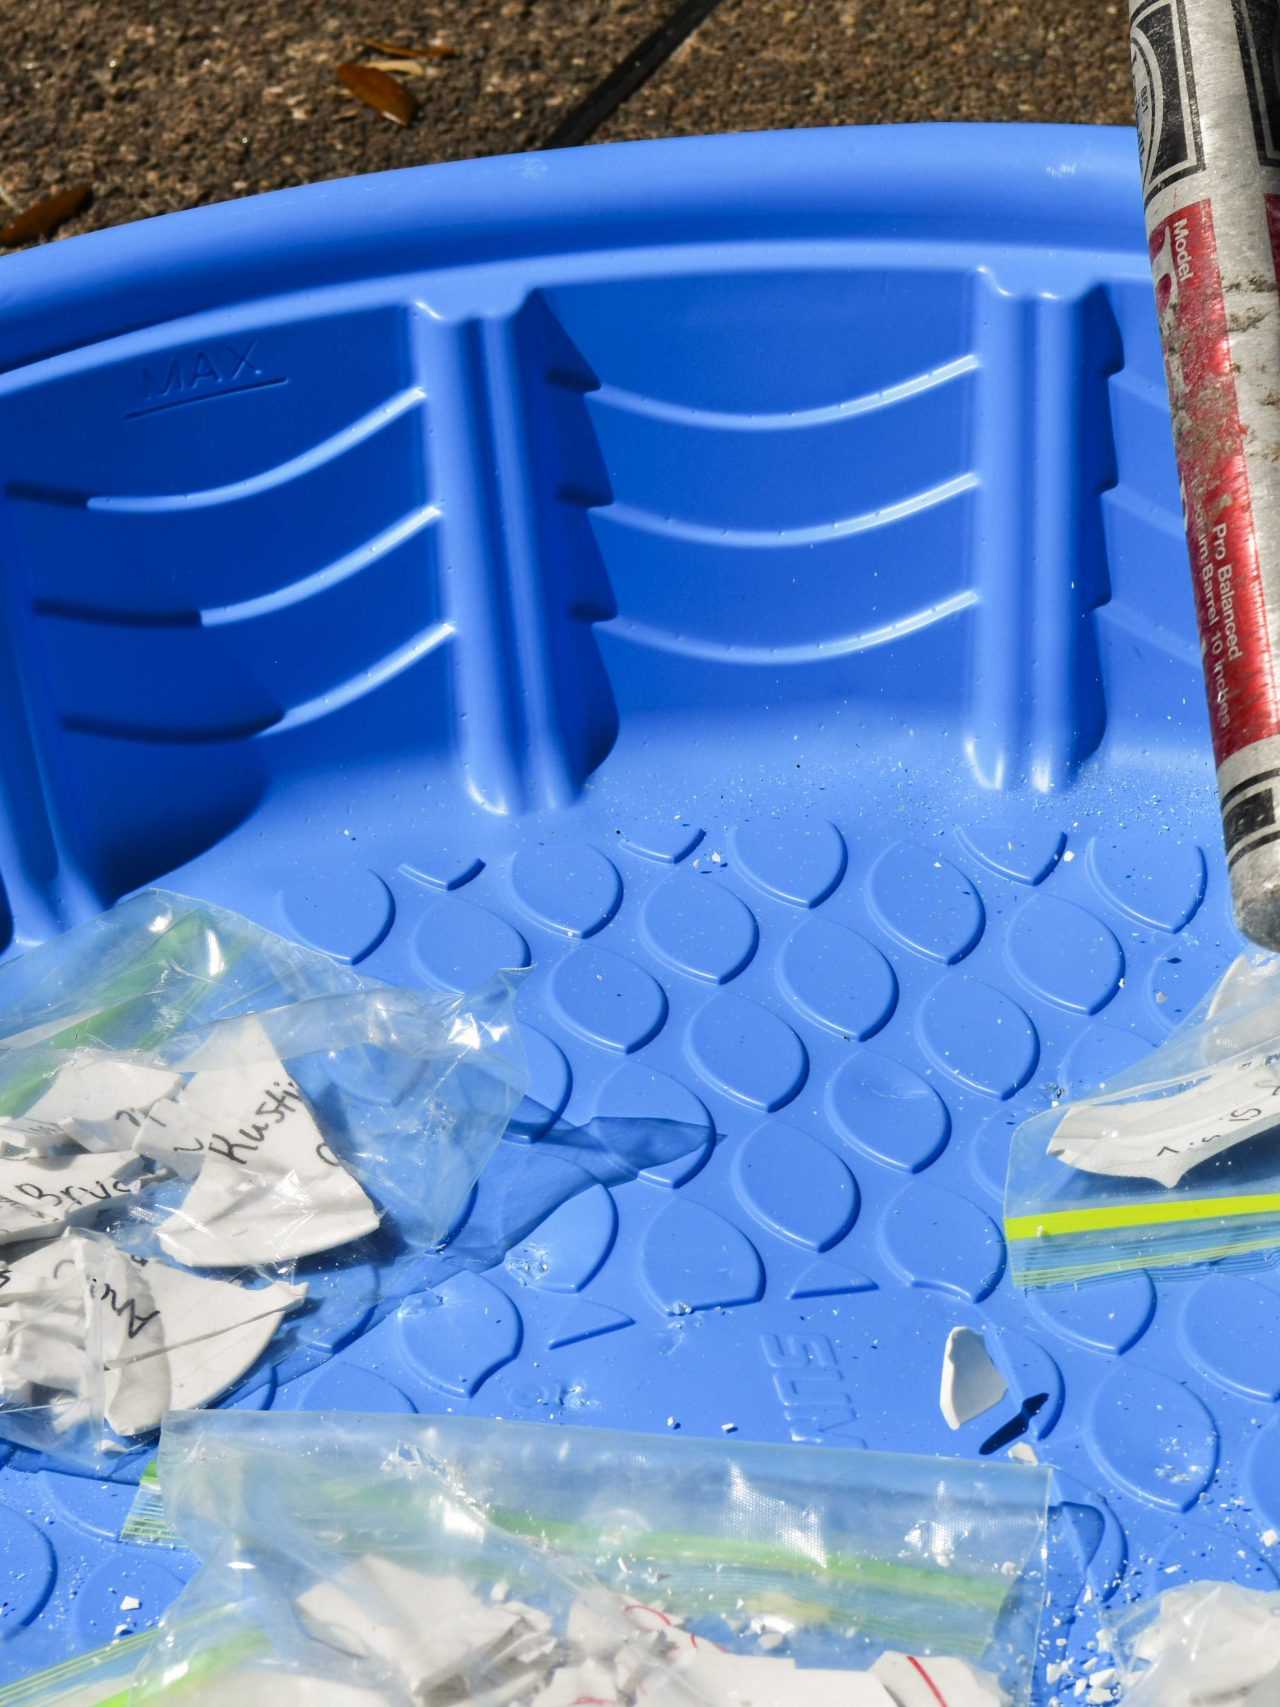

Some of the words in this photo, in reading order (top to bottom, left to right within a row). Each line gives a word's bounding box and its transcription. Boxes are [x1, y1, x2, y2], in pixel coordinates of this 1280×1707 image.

[1173, 218, 1194, 282] Model
[1212, 522, 1227, 561] Pro
[1201, 563, 1221, 627] Barrel
[1217, 563, 1244, 661] Balanced
[1210, 630, 1223, 655] 10
